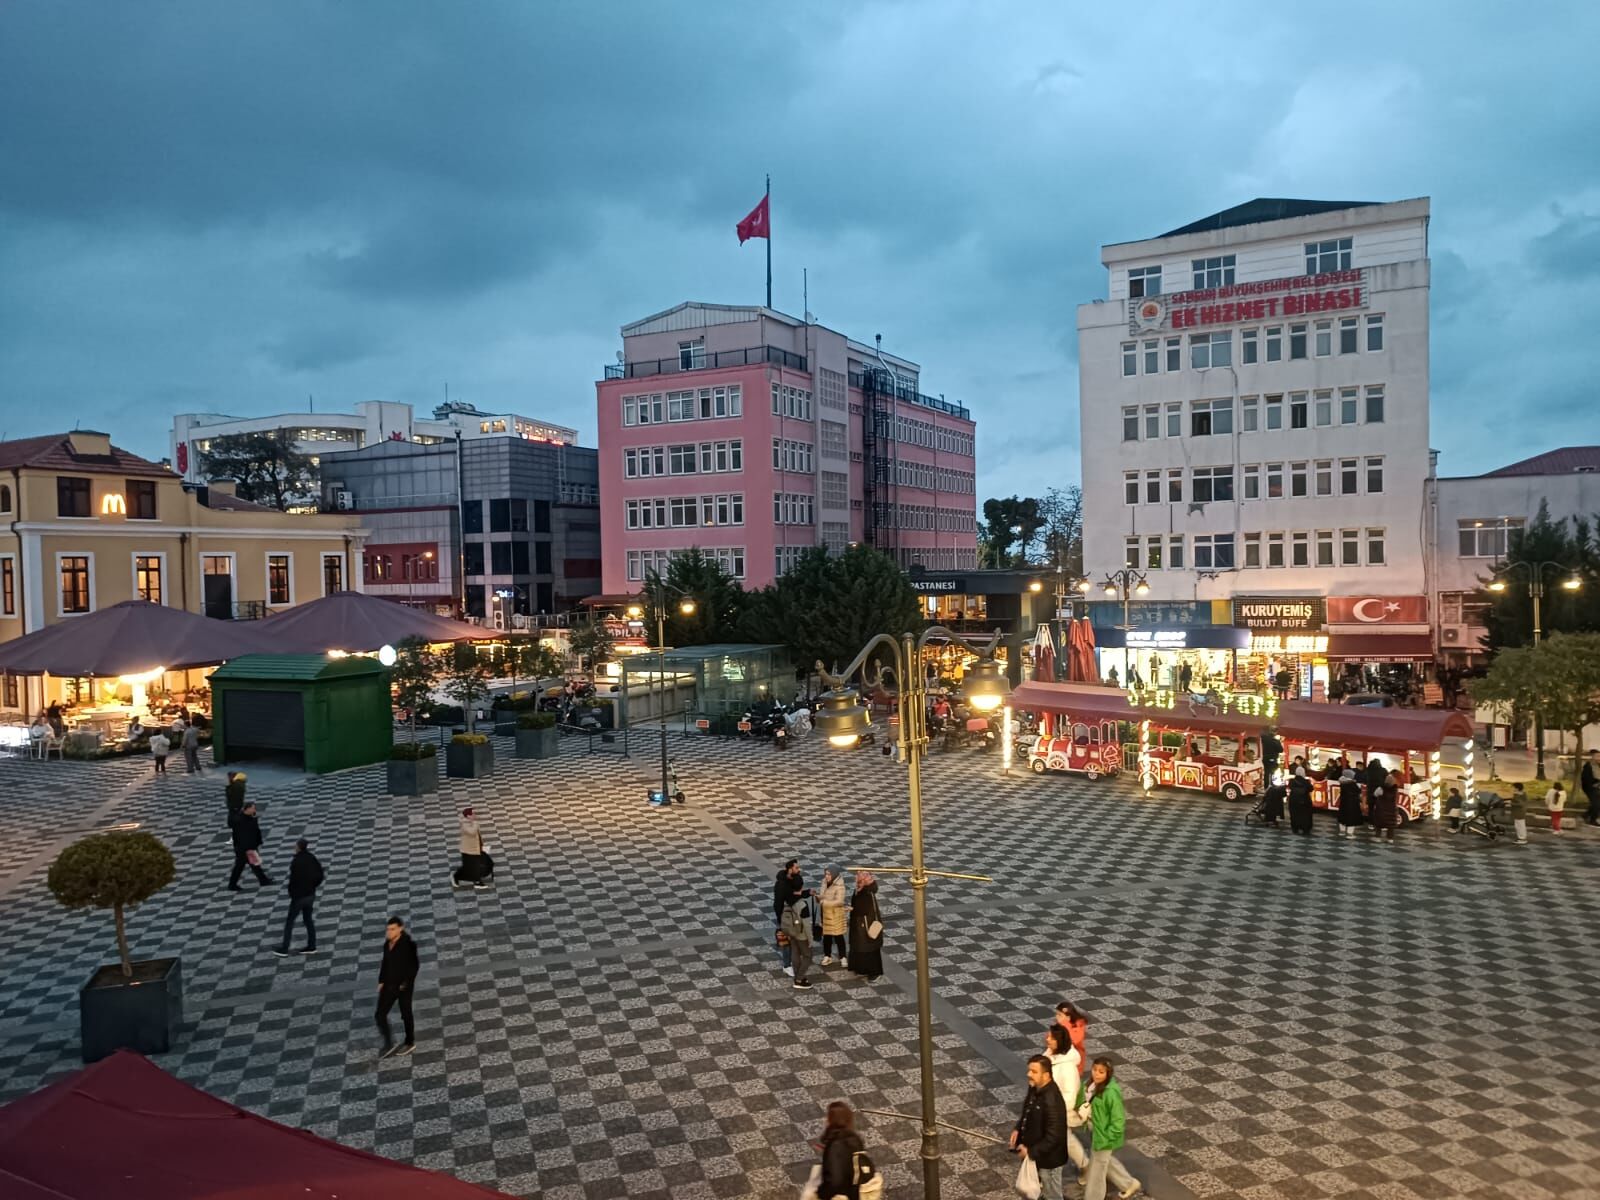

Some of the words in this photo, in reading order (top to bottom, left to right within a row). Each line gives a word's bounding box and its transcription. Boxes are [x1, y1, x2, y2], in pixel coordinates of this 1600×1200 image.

[1172, 308, 1197, 328] EK
[1242, 602, 1312, 619] KURUYEMİŞ
[1247, 619, 1277, 627] BULUT
[1282, 618, 1308, 627] BÜFE
